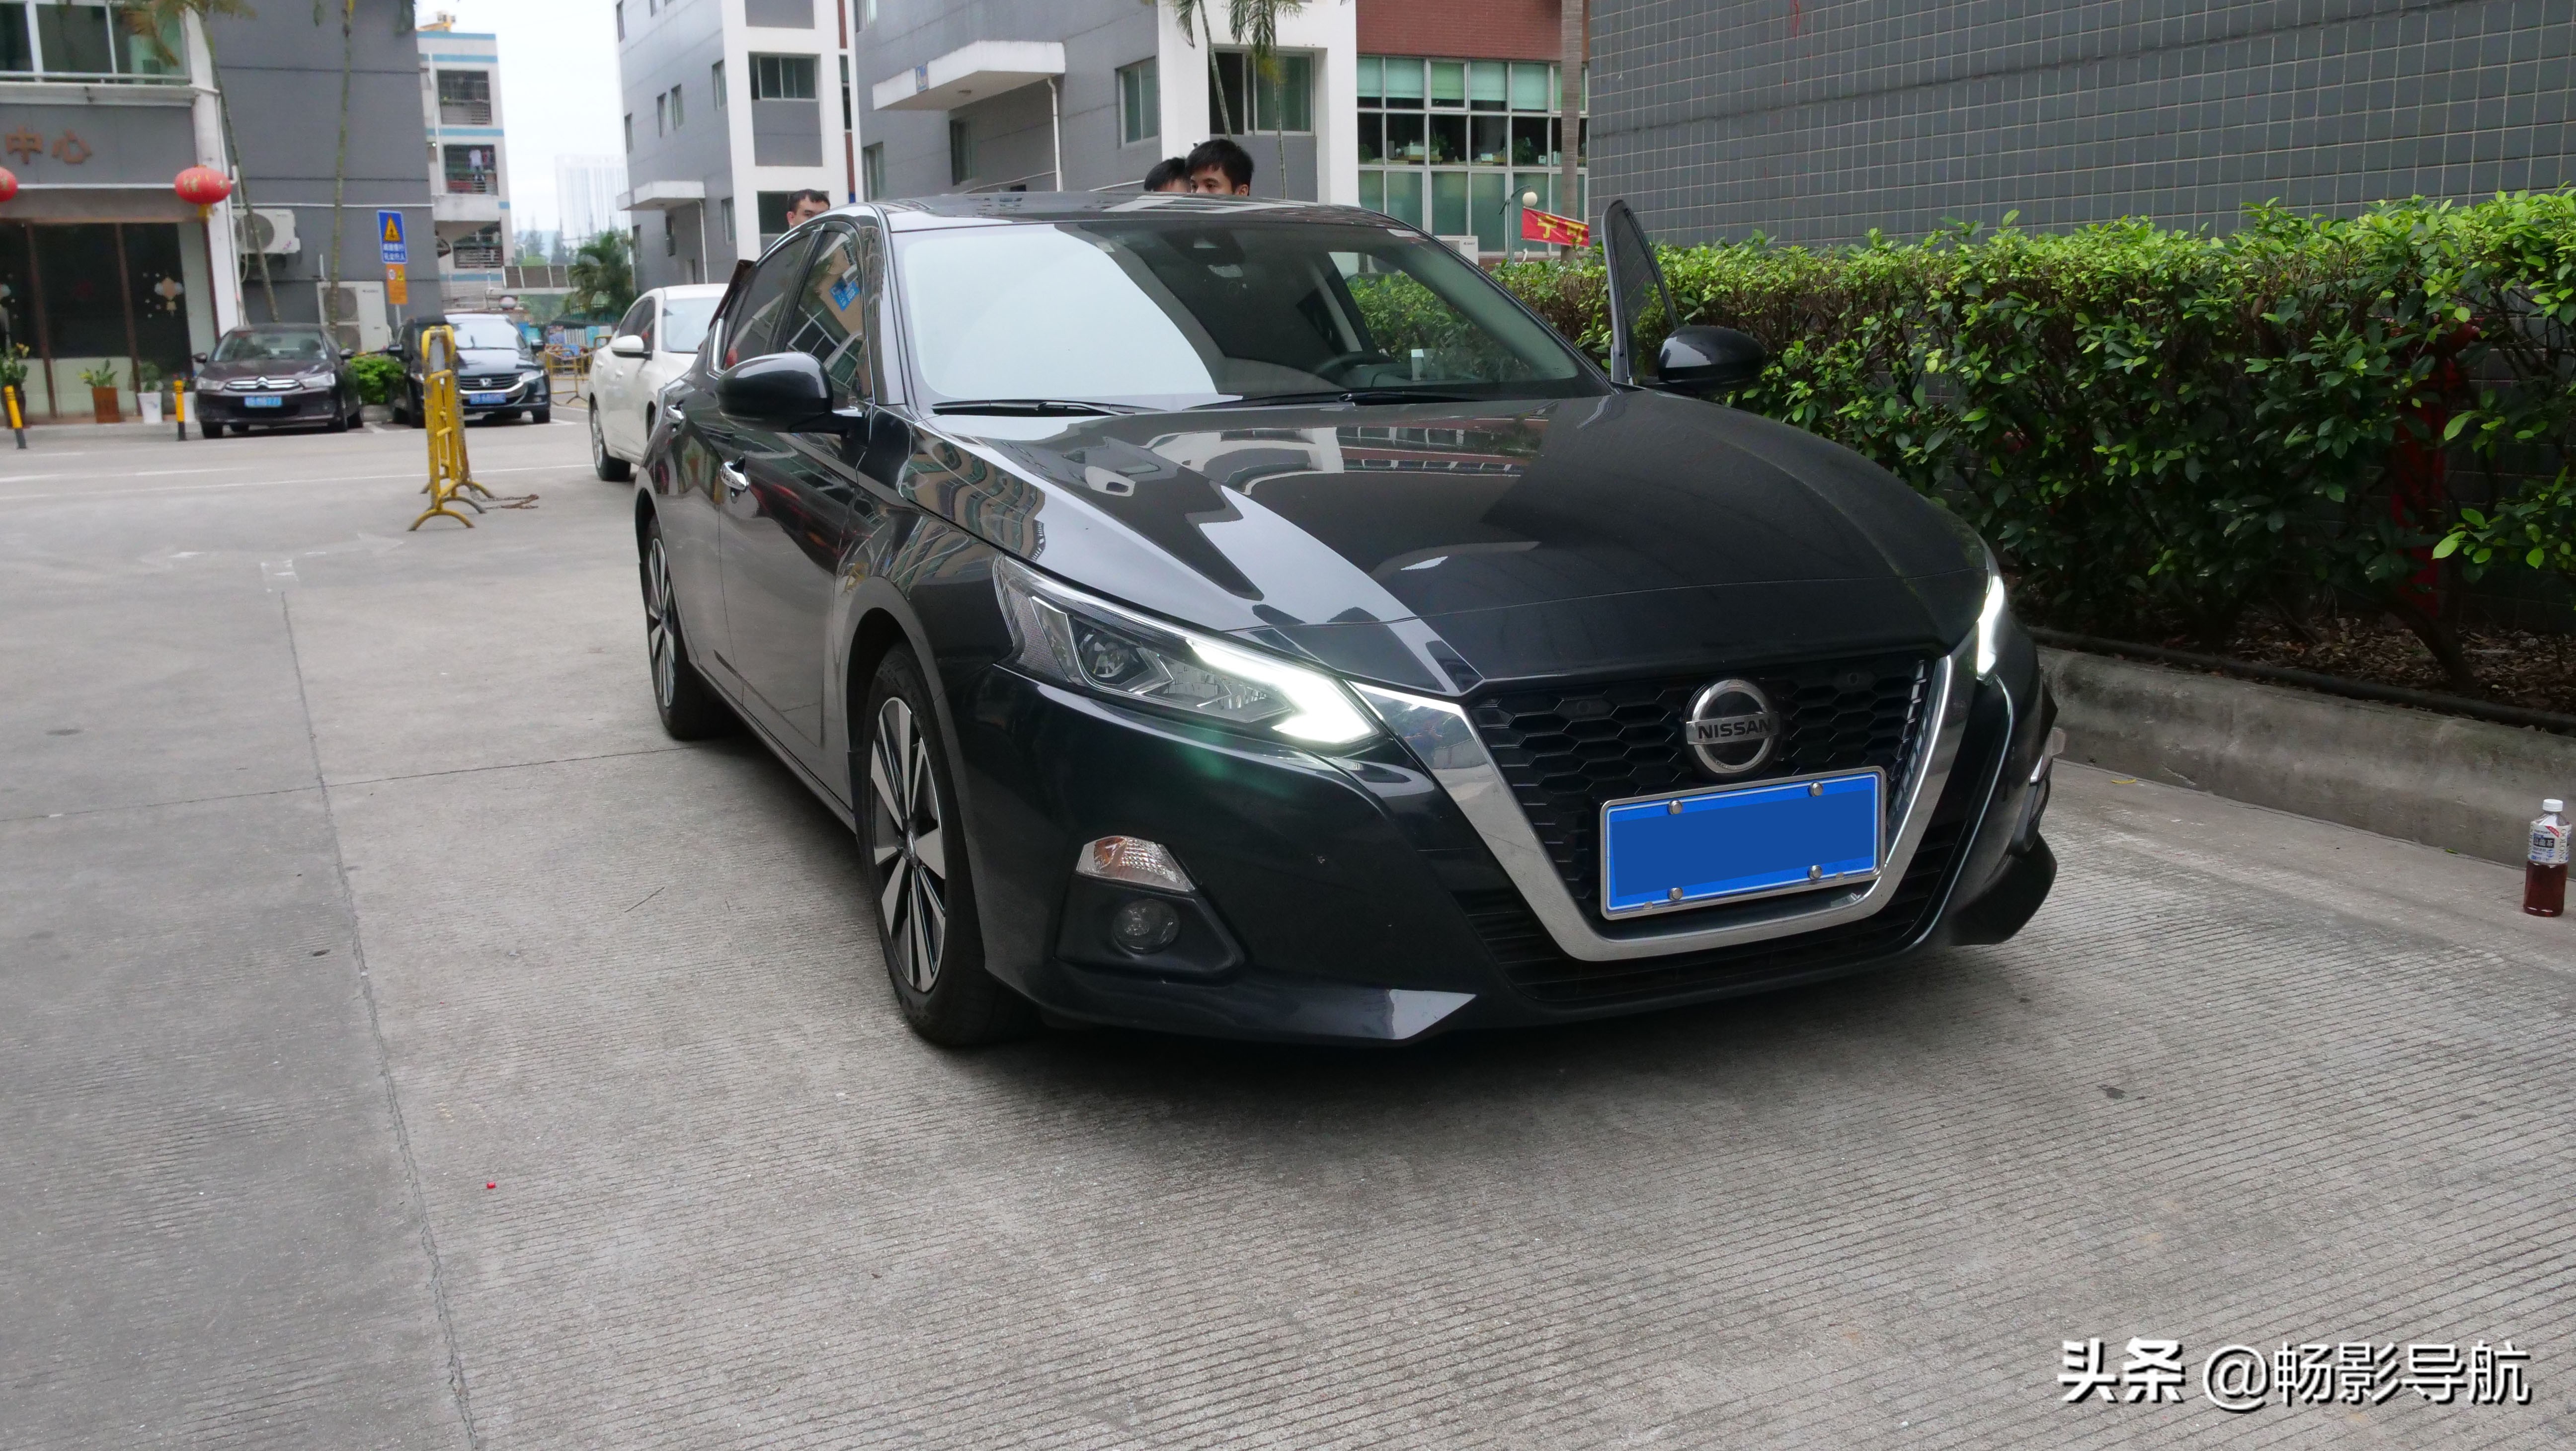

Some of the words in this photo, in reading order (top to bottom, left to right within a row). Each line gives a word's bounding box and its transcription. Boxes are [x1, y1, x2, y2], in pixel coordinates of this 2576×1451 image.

[5, 126, 91, 165] 中心
[1698, 719, 1772, 739] NISSAN
[2558, 829, 2567, 863] OOLONG
